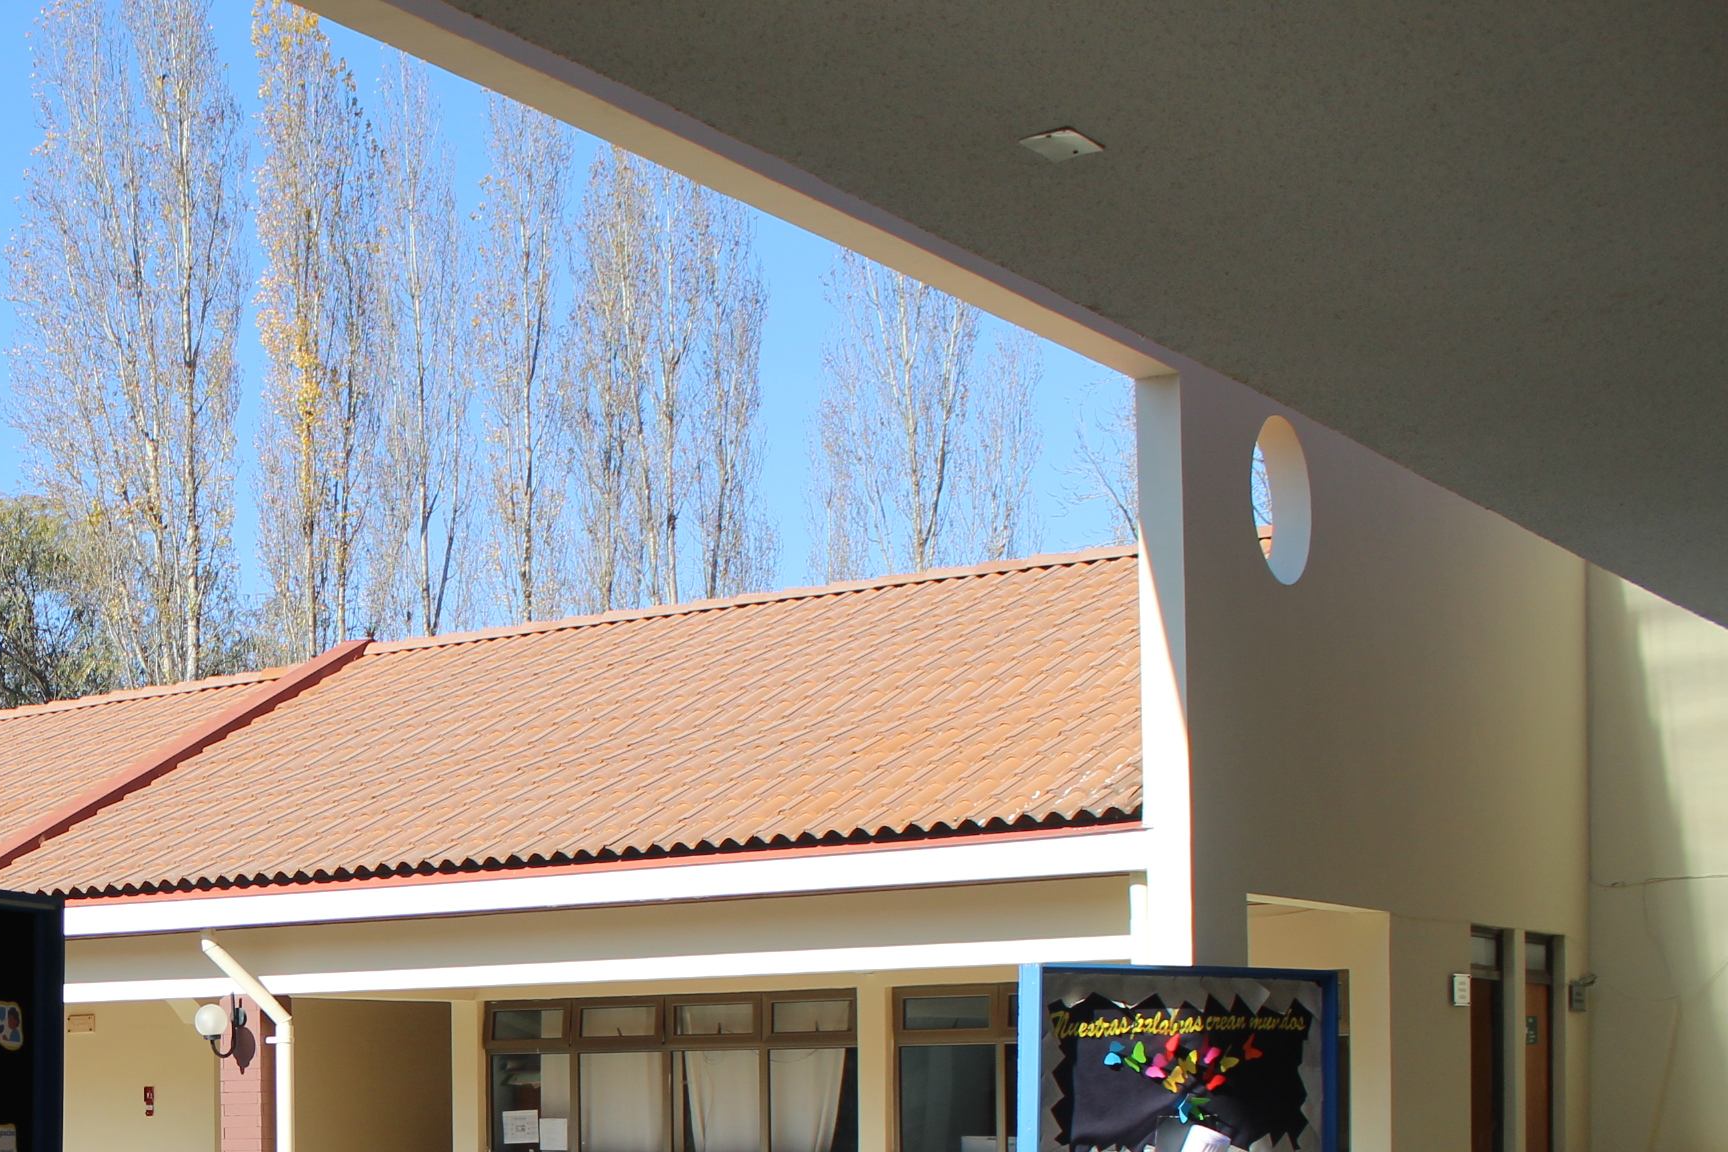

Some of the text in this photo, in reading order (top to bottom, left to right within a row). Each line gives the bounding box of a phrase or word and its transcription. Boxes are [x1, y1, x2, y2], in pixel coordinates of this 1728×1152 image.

[1051, 1008, 1307, 1040] Nuestras palabras crean mundos
